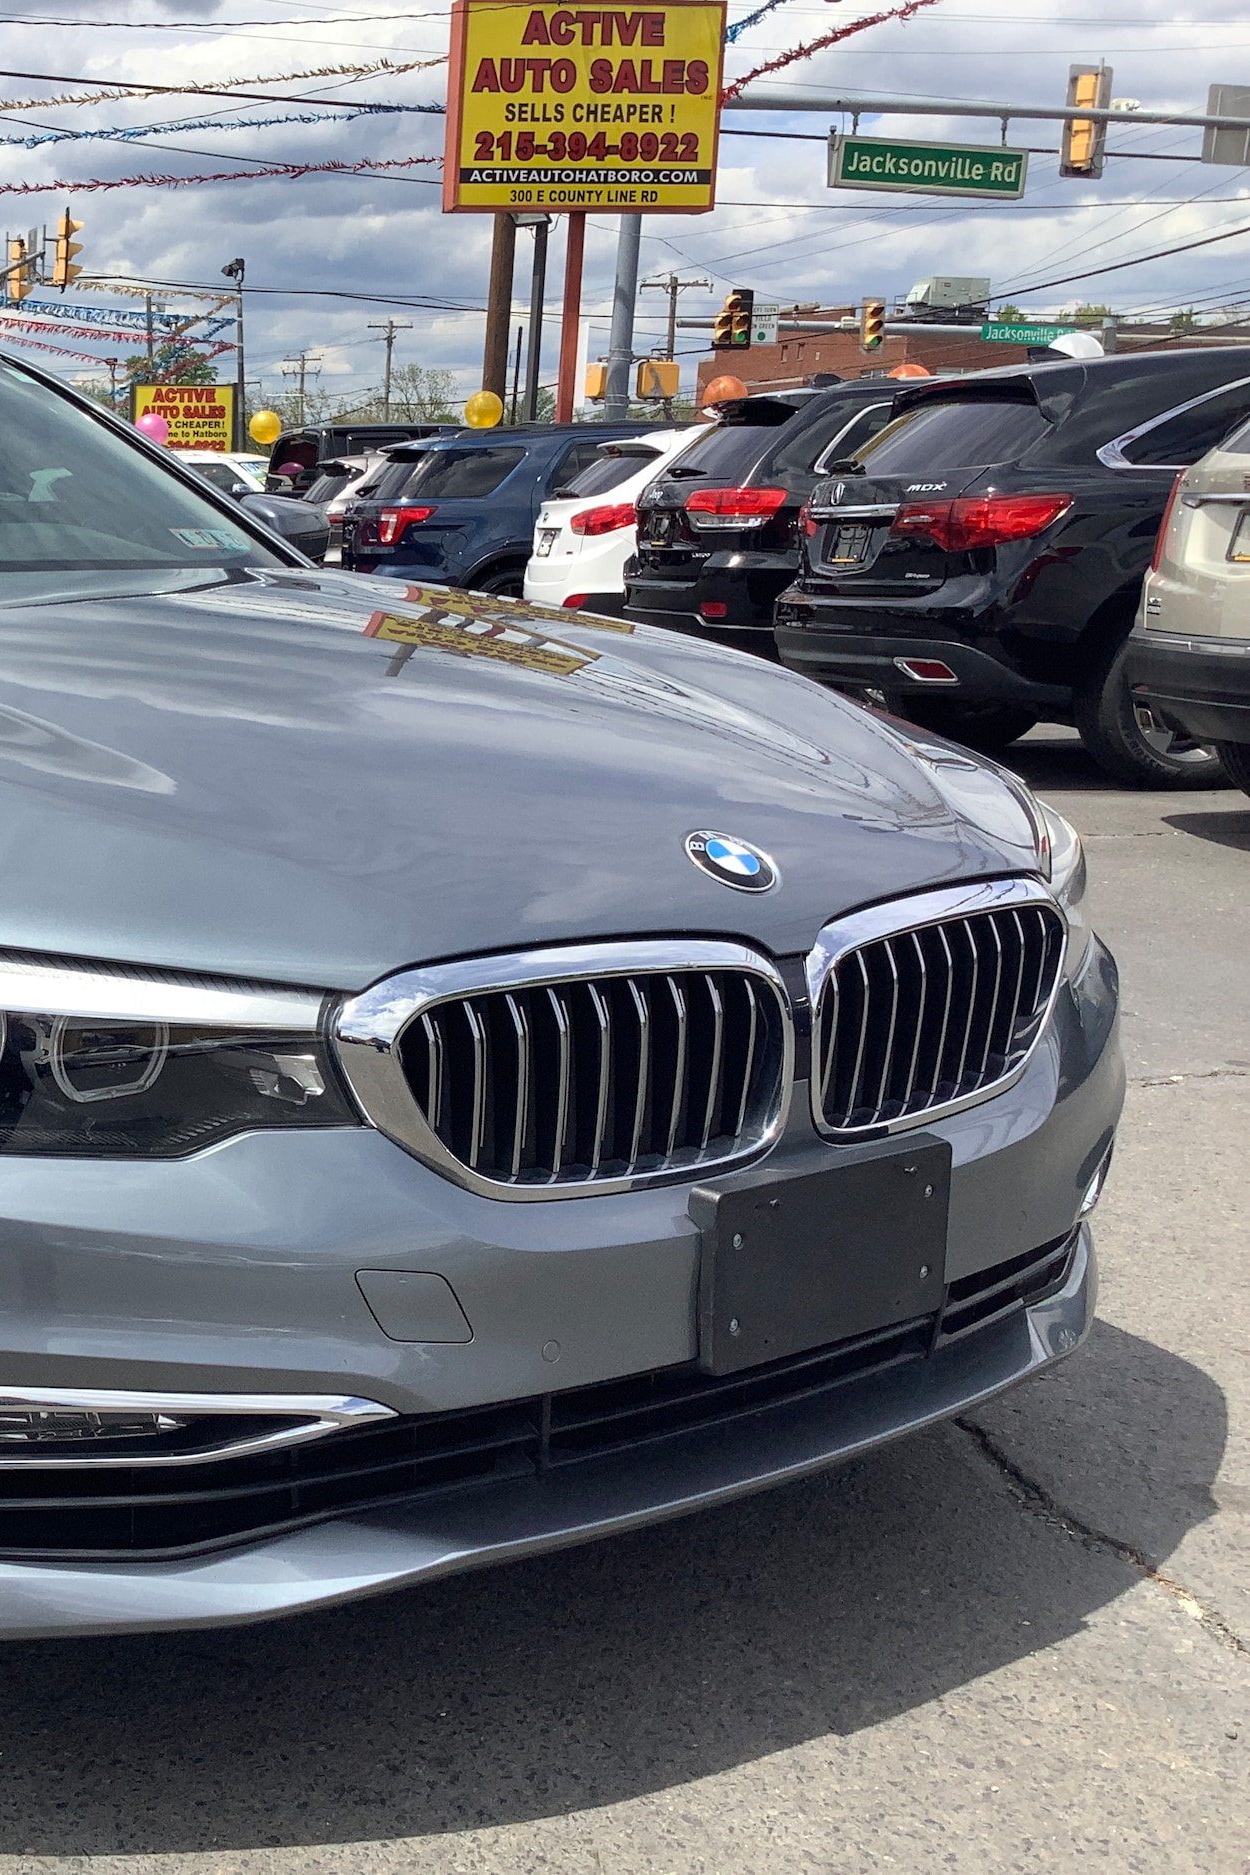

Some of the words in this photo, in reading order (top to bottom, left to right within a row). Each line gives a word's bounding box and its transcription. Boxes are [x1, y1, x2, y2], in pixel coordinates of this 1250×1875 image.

[521, 10, 666, 47] ACTIVE
[471, 57, 577, 94] AUTO
[589, 59, 709, 95] SALES
[505, 103, 564, 123] SELLS
[573, 103, 663, 123] CHEAPER
[473, 131, 699, 162] 215-394-8922
[847, 152, 983, 180] Jacksonville
[990, 161, 1016, 183] Rd
[470, 169, 698, 184] ACTIVEAUTOHATBORO.COM
[510, 190, 532, 202] 300
[537, 190, 544, 202] E
[549, 190, 603, 203] COUNTY
[607, 190, 637, 203] LINE
[641, 190, 658, 203] RD
[986, 326, 1054, 342] Jacksonville
[152, 388, 216, 402] ACTIVE
[142, 405, 180, 419] AUTO
[183, 405, 226, 419] SALES
[181, 430, 190, 438] to
[192, 430, 228, 438] Hatboro
[906, 483, 947, 492] MDX
